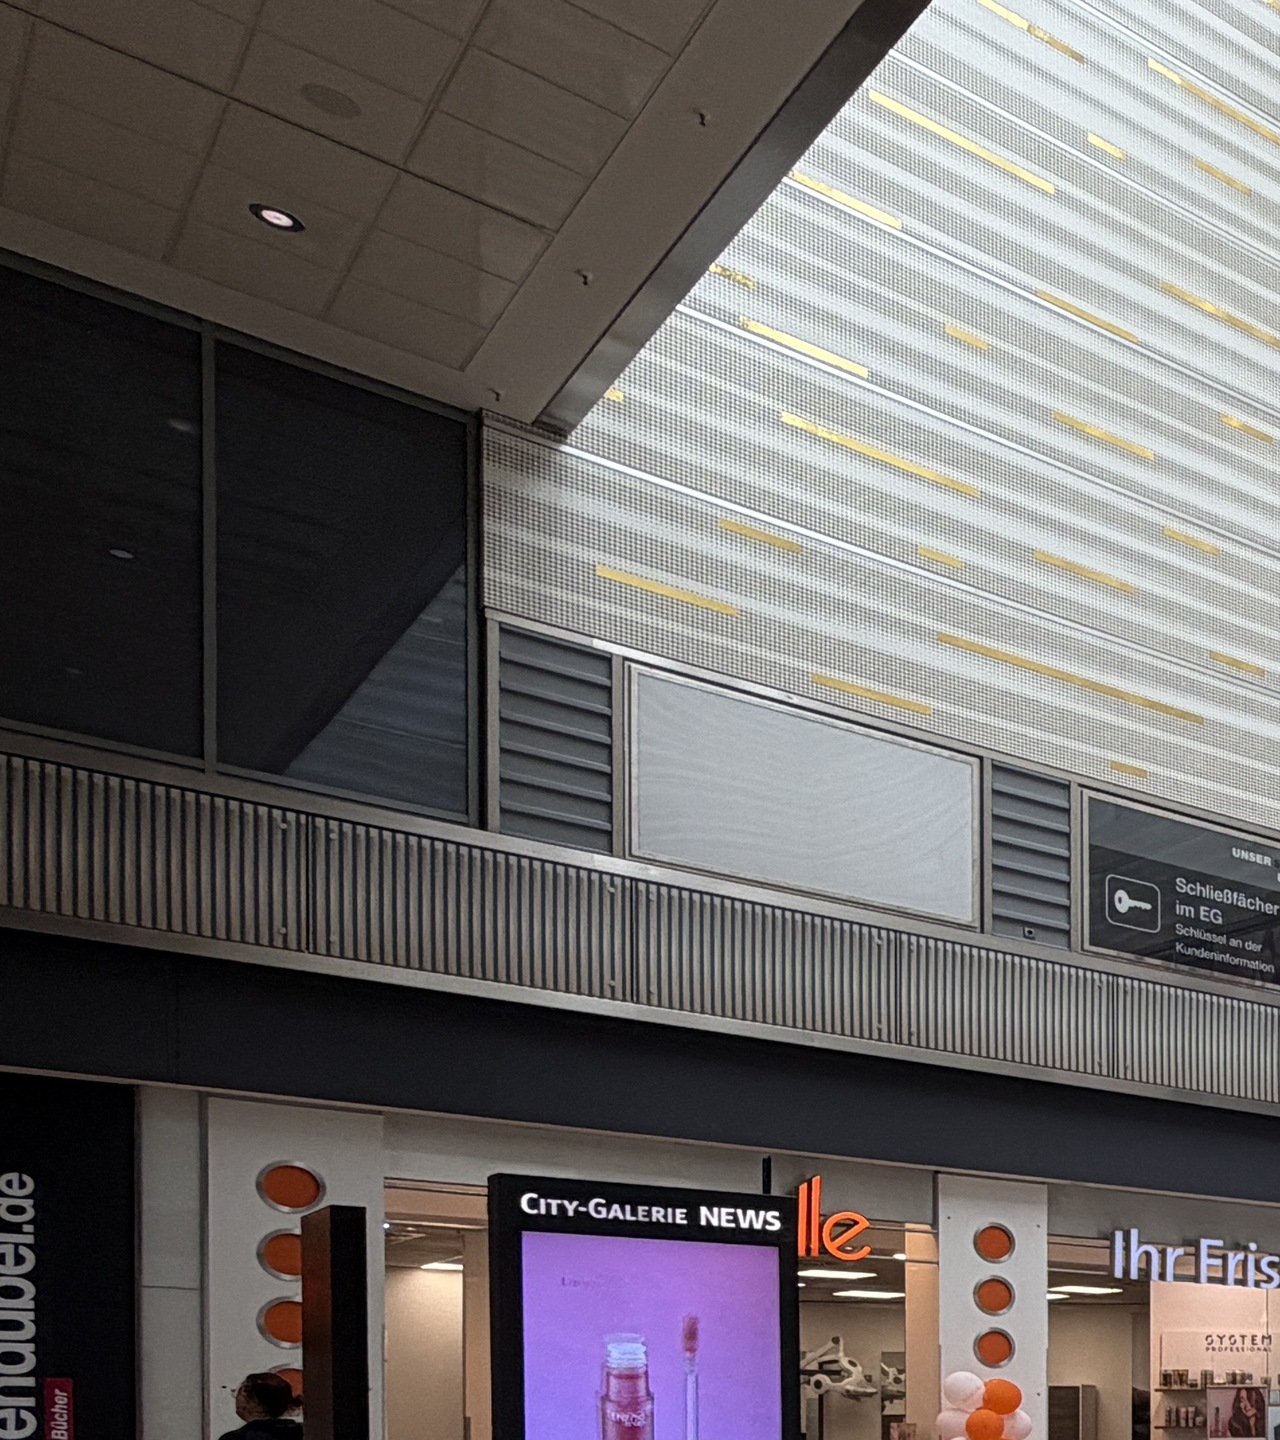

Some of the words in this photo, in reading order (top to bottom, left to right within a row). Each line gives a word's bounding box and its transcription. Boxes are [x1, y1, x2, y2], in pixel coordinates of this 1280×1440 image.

[1232, 847, 1272, 867] UNSER
[1175, 877, 1280, 917] Schließfächer
[1175, 900, 1195, 919] im
[1199, 907, 1223, 926] EG
[1175, 923, 1227, 946] Schlüssel
[1228, 937, 1243, 949] an
[1245, 937, 1263, 954] der
[1175, 942, 1276, 974] Kundeninformation
[699, 1205, 782, 1231] NEWS
[1113, 1228, 1184, 1282] Ihr
[1204, 1333, 1273, 1346] SYSTEM
[50, 1387, 70, 1440] Bücher
